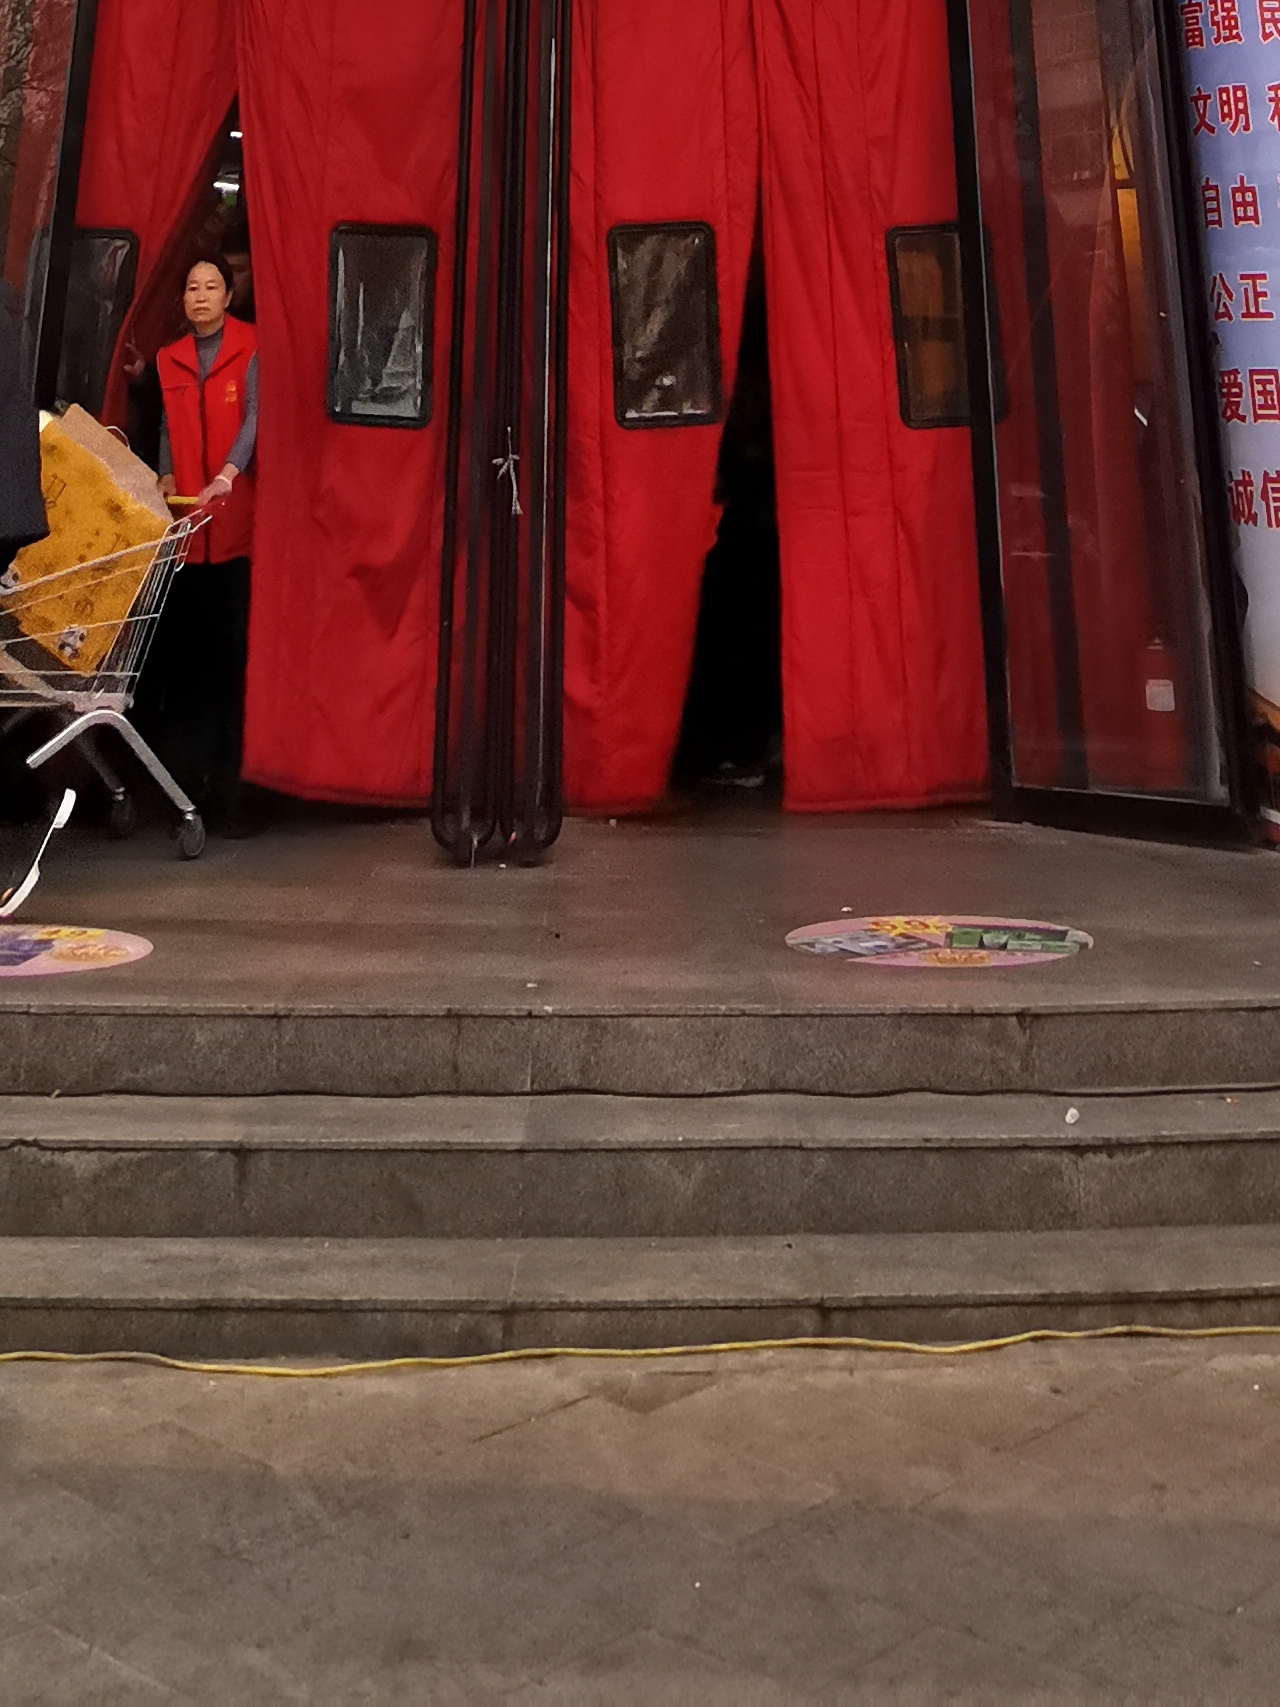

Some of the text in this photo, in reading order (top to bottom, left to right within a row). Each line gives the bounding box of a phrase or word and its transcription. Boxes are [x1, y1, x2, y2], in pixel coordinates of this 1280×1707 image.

[1189, 83, 1253, 137] 文明
[1199, 173, 1262, 230] 自由
[1209, 271, 1275, 323] 公正
